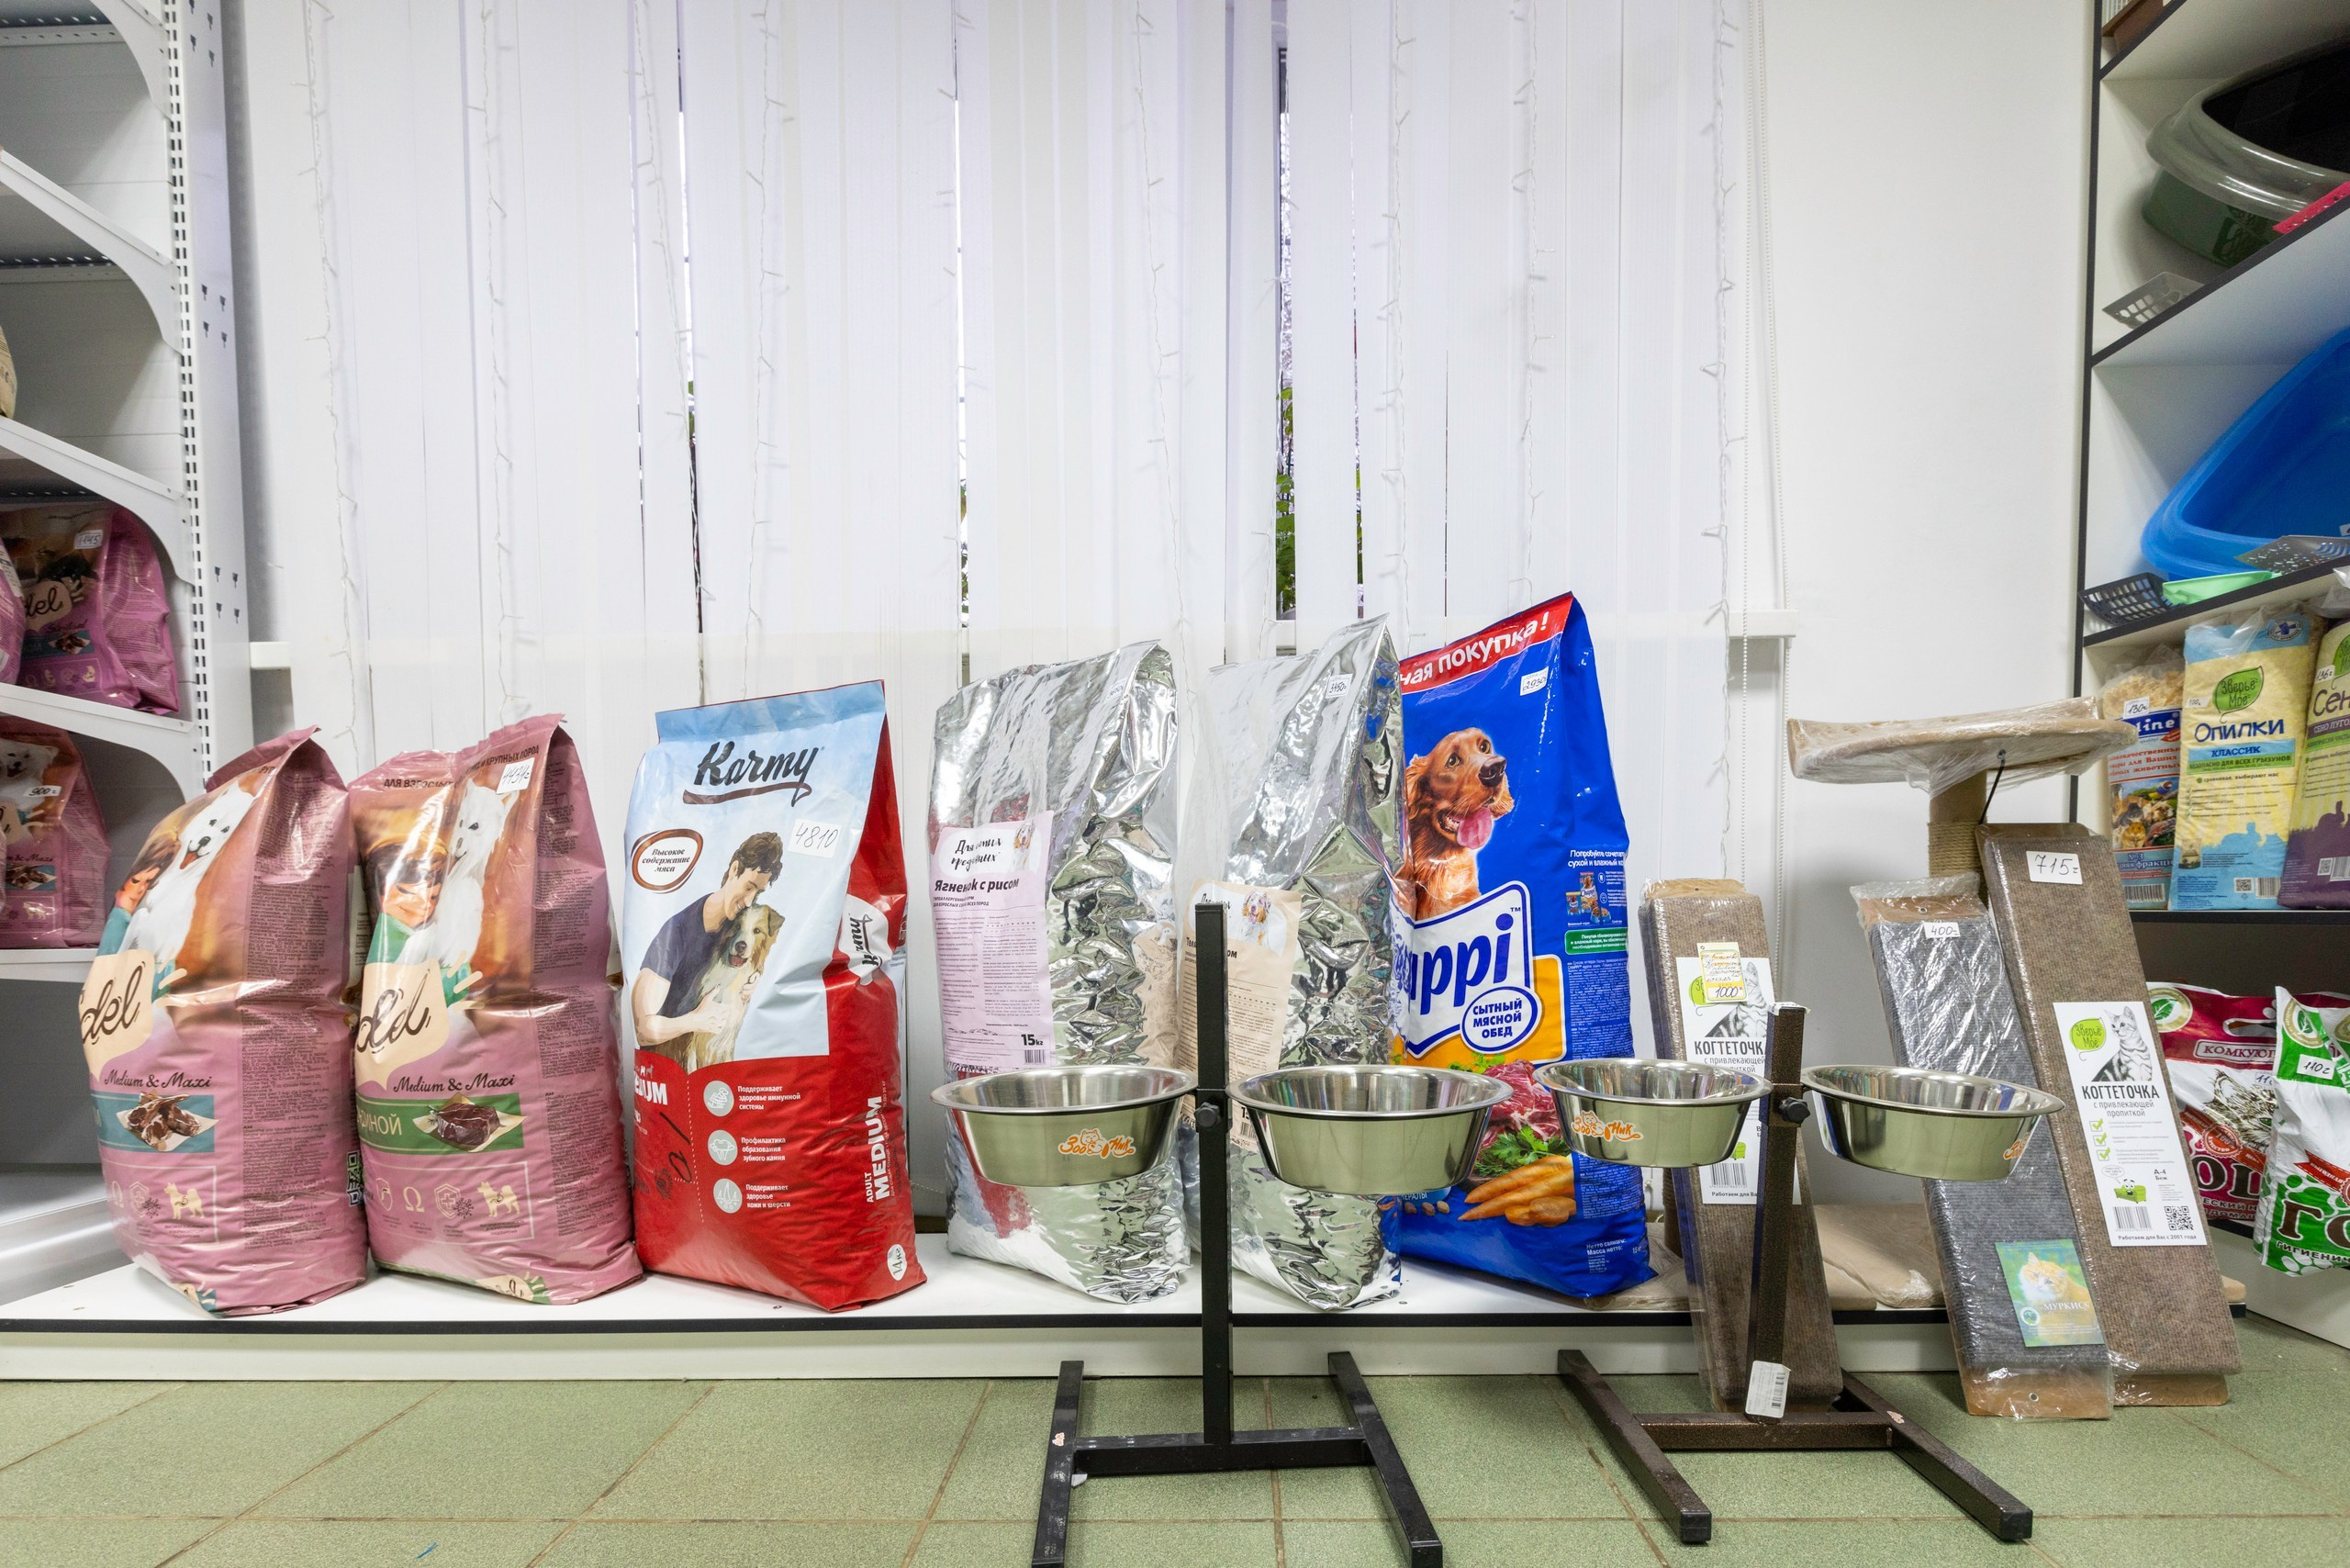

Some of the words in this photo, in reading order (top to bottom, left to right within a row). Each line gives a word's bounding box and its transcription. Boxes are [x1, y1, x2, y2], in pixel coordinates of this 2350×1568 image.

[1438, 610, 1549, 675] покупка!
[2211, 745, 2261, 758] КЛАССИК
[693, 740, 820, 808] Karmy
[384, 778, 402, 789] ДЛЯ
[795, 822, 839, 849] 4810
[652, 847, 686, 857] Высокое
[642, 856, 691, 866] содержание
[1567, 858, 1588, 869] сухой
[654, 864, 676, 873] мяса
[934, 879, 979, 893] Ягненок
[979, 880, 986, 891] с
[987, 878, 1020, 893] рисом
[1472, 997, 1523, 1015] СЫТНЫЙ
[1472, 1012, 1522, 1027] МЯСНОЙ
[1481, 1025, 1513, 1039] ОБЕД
[1694, 1040, 1764, 1056] КОГТЕТОЧК
[1704, 1057, 1708, 1065] с
[105, 1069, 144, 1087] Medium
[146, 1073, 160, 1088] &
[162, 1070, 213, 1089] Maxi
[393, 1076, 444, 1093] Medium
[447, 1077, 463, 1091] &
[465, 1073, 515, 1090] Maxi
[737, 1085, 783, 1093] Поддерживает
[2081, 1084, 2161, 1100] КОГТЕТОЧКА
[767, 1092, 801, 1102] иммунной
[2093, 1101, 2098, 1109] с
[2098, 1099, 2154, 1110] привлекающей
[2106, 1108, 2146, 1119] пропиткой
[741, 1137, 787, 1145] Профилактика
[865, 1095, 890, 1201] MEDIUM
[745, 1183, 789, 1192] Поддерживает
[864, 1171, 875, 1204] ADULT
